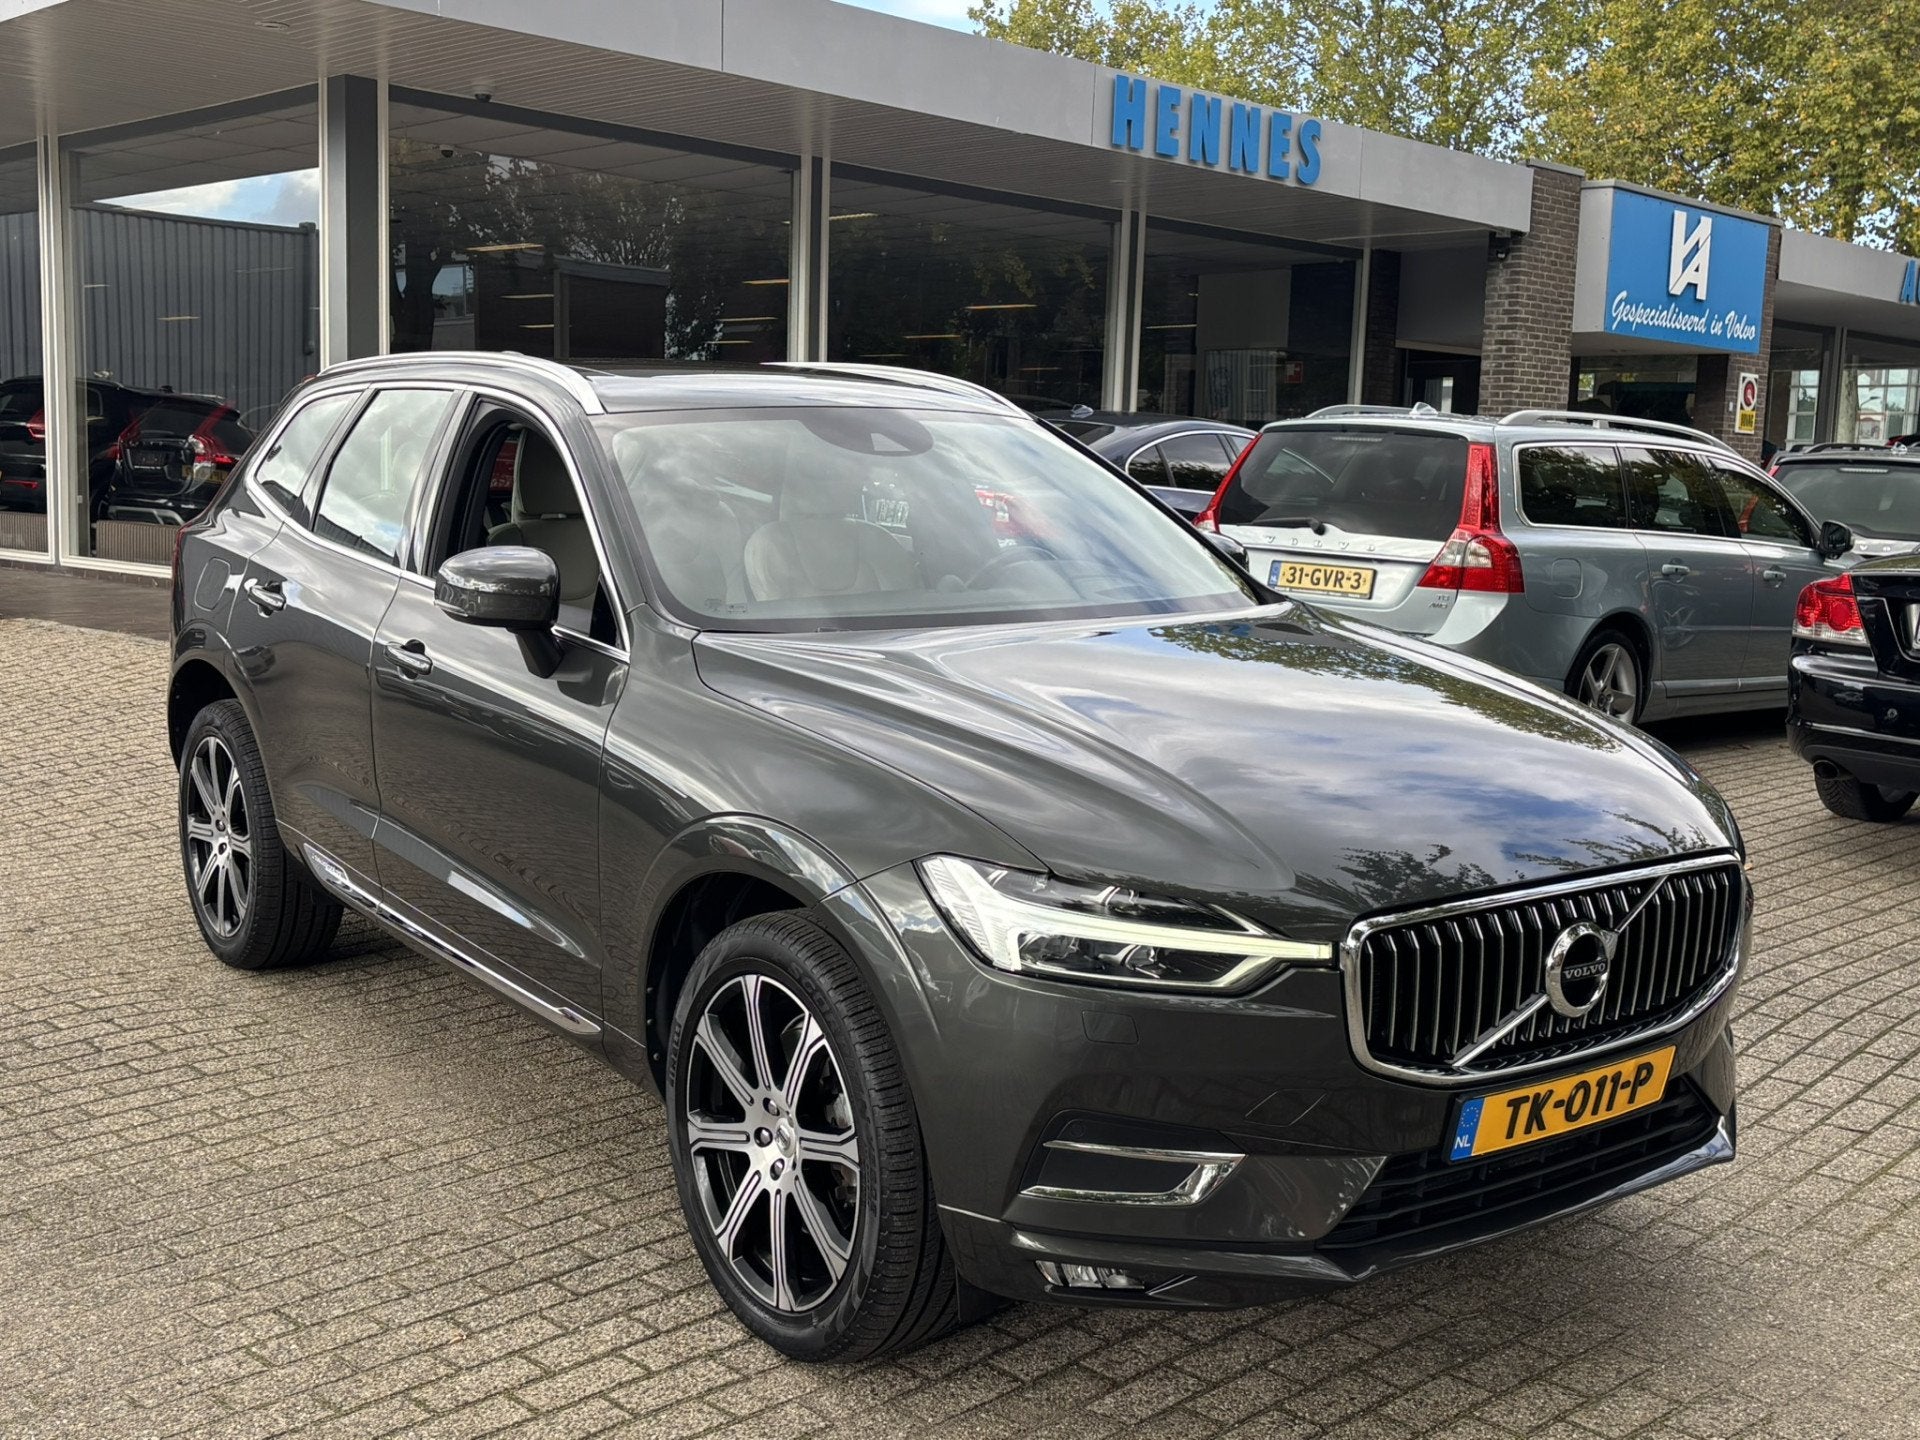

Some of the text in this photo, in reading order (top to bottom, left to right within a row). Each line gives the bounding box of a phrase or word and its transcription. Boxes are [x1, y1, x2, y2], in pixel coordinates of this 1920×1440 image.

[1112, 75, 1322, 185] HENNES
[1611, 291, 1756, 341] Gespecialiseerd in Volvo
[1286, 566, 1361, 590] 31-GVR-3
[1562, 963, 1606, 979] VOLVO
[1505, 1061, 1655, 1140] TK-011-P
[1454, 1134, 1471, 1149] NL
